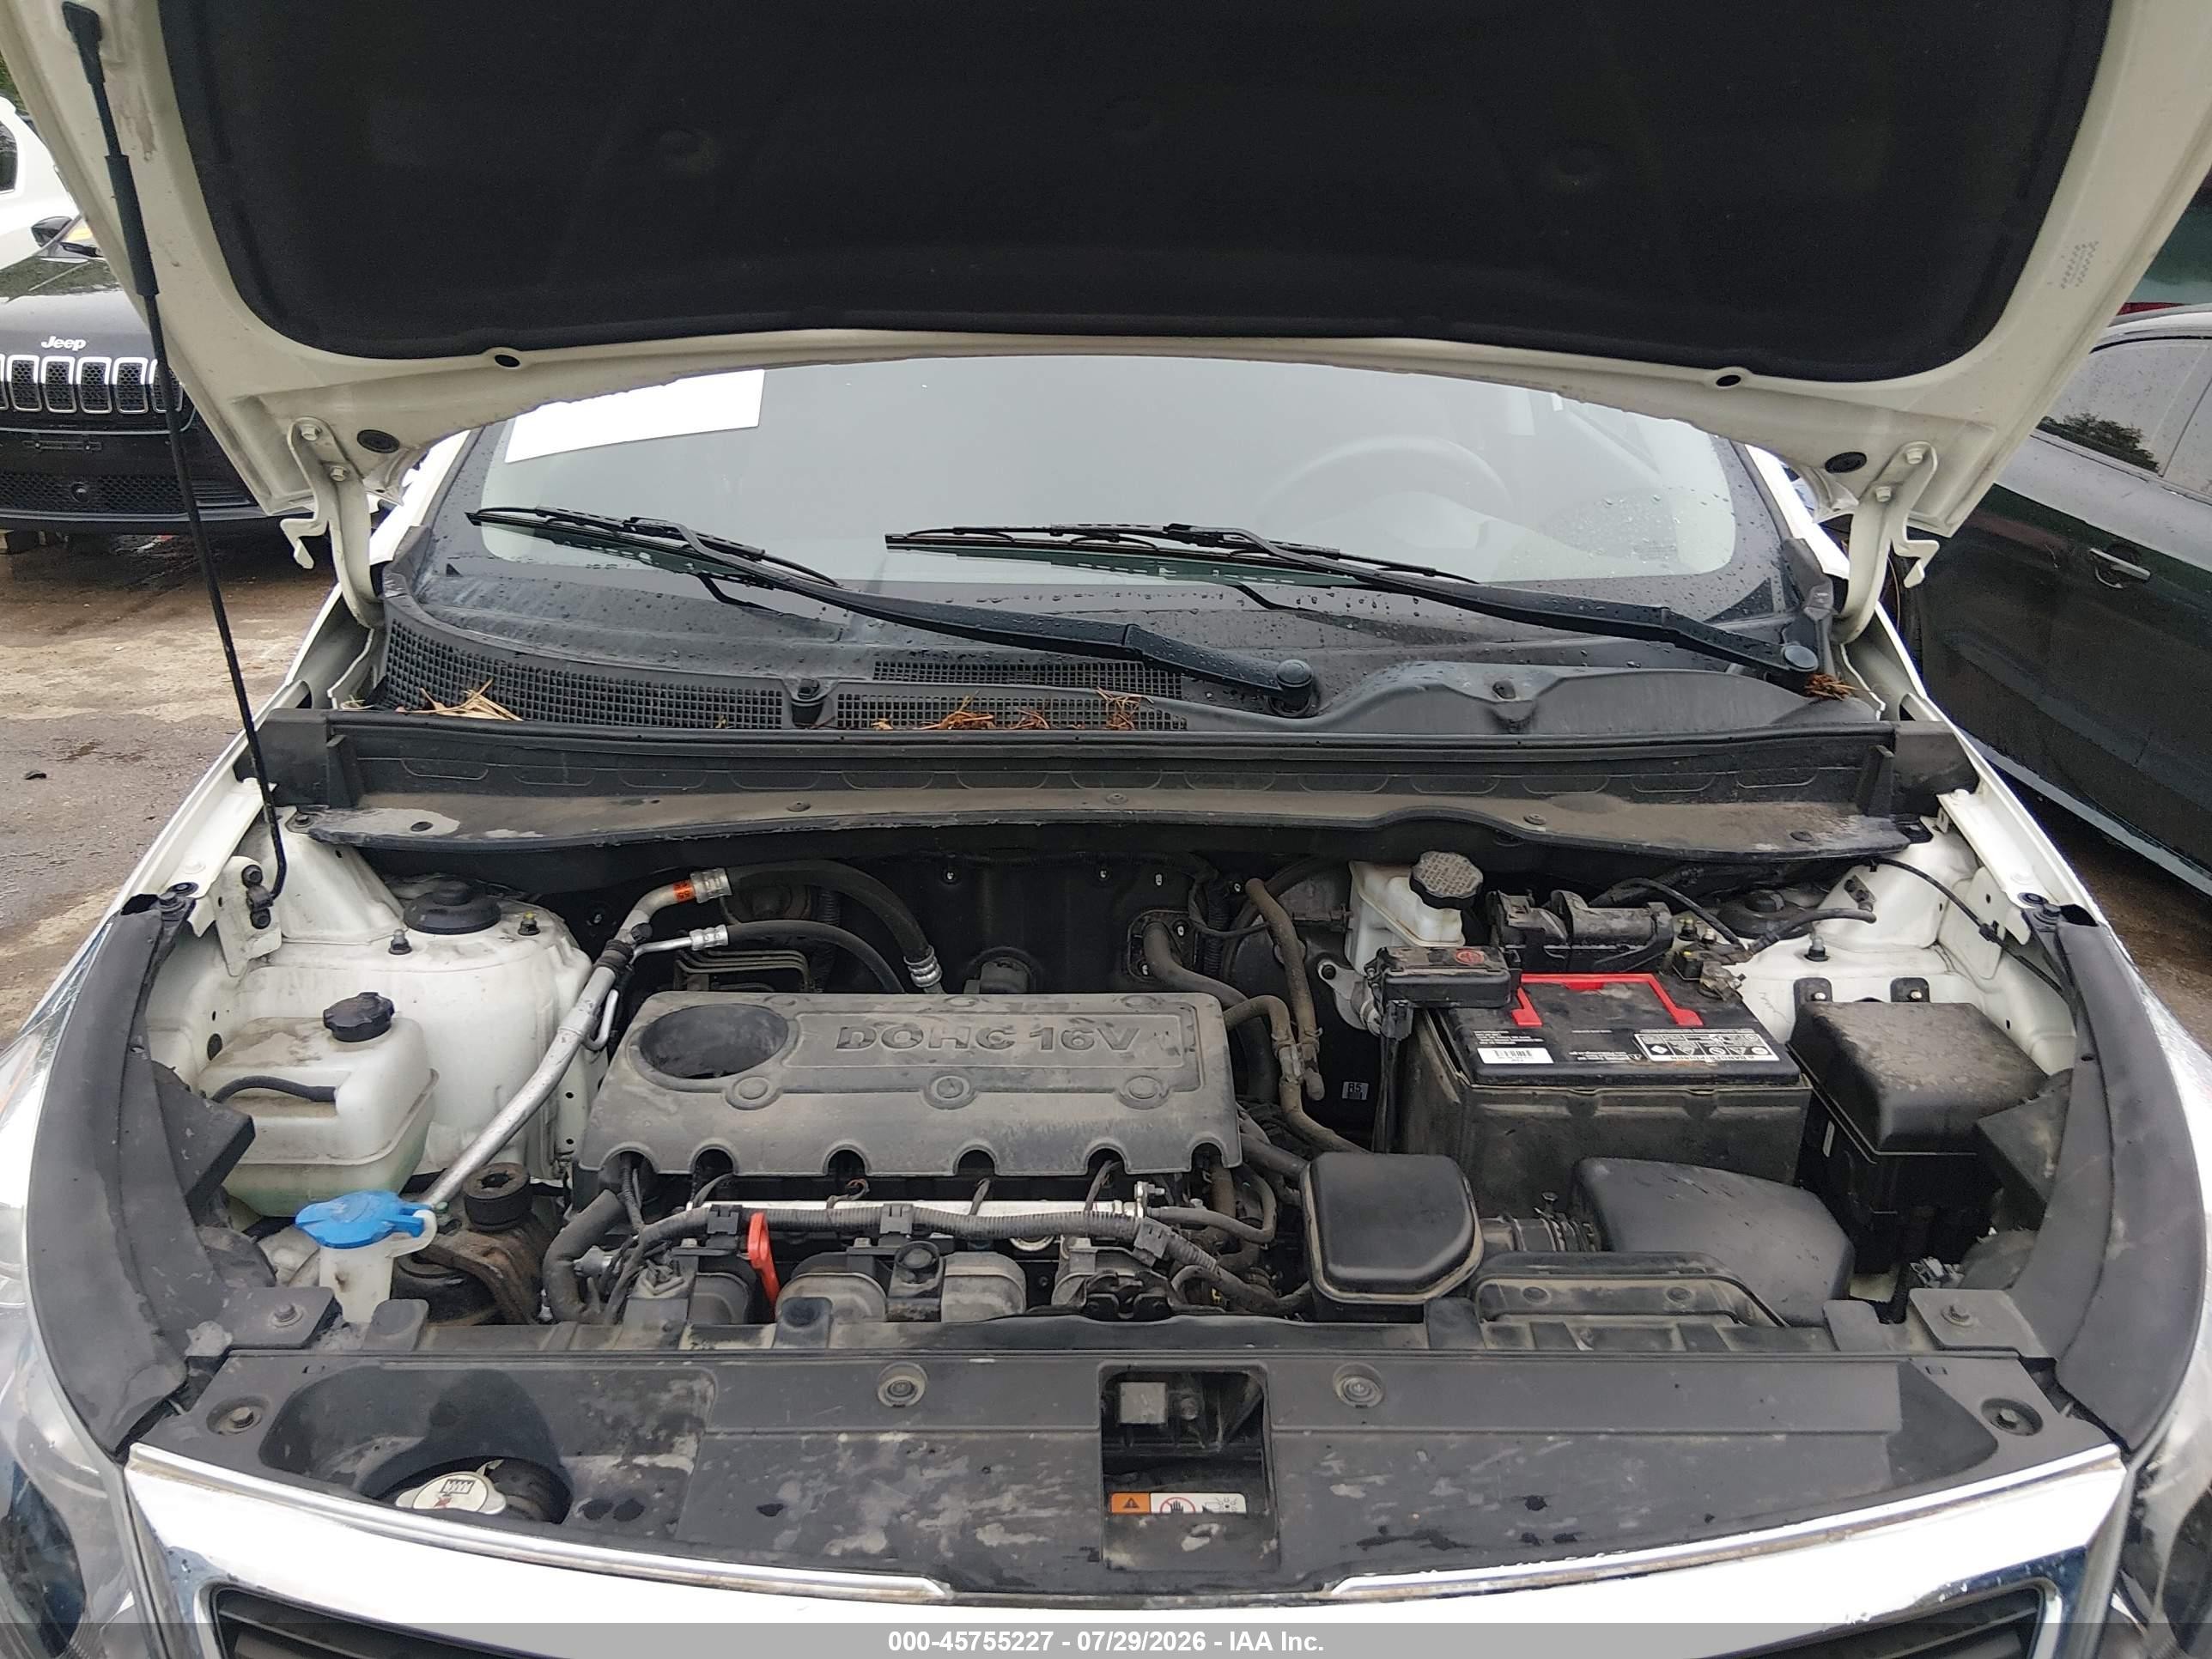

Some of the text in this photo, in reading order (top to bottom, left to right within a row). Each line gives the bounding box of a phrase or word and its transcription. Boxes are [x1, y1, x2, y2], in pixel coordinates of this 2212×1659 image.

[41, 336, 87, 351] Jeep
[836, 1025, 1140, 1051] DOHC 16V
